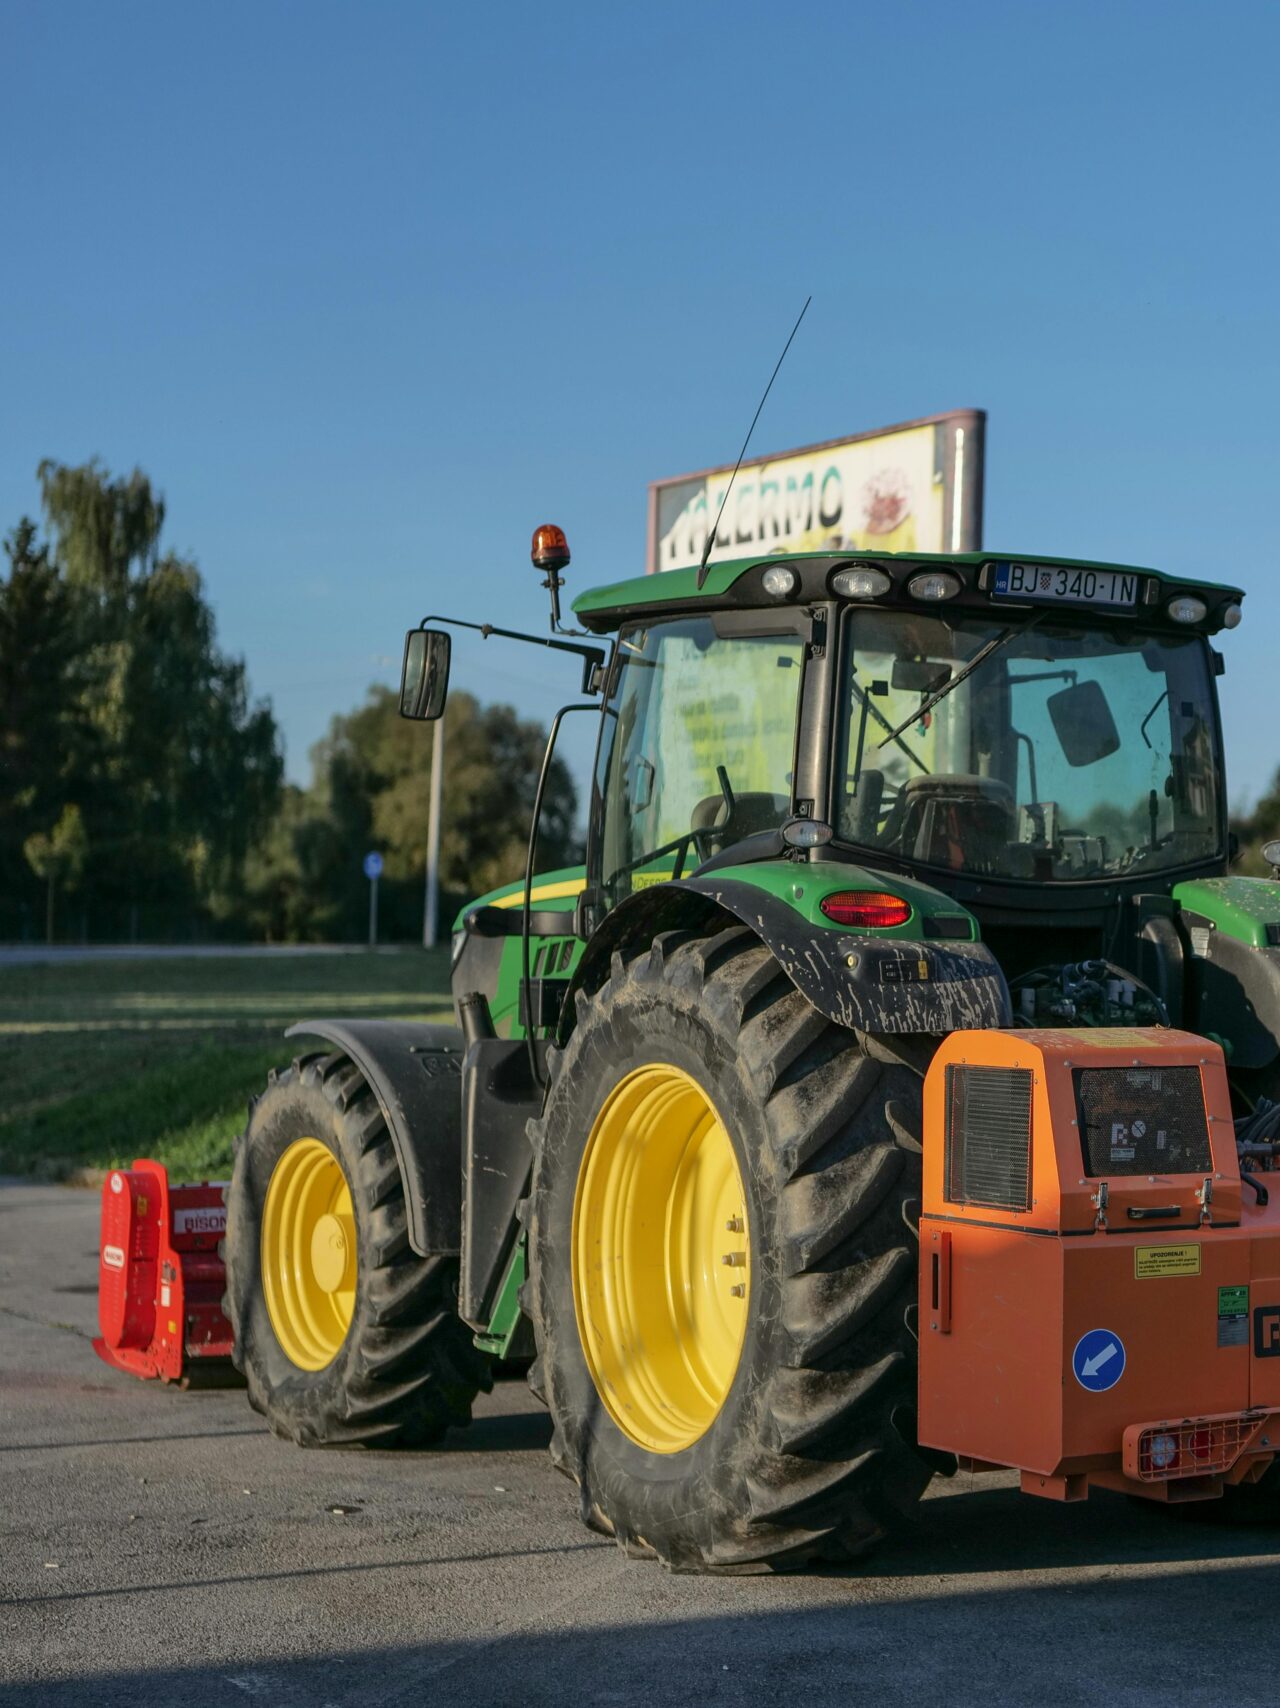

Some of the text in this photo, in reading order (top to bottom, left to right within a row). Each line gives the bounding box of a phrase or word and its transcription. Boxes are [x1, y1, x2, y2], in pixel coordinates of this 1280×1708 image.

[996, 580, 1007, 589] HR
[1010, 565, 1134, 601] BJ 340-IN
